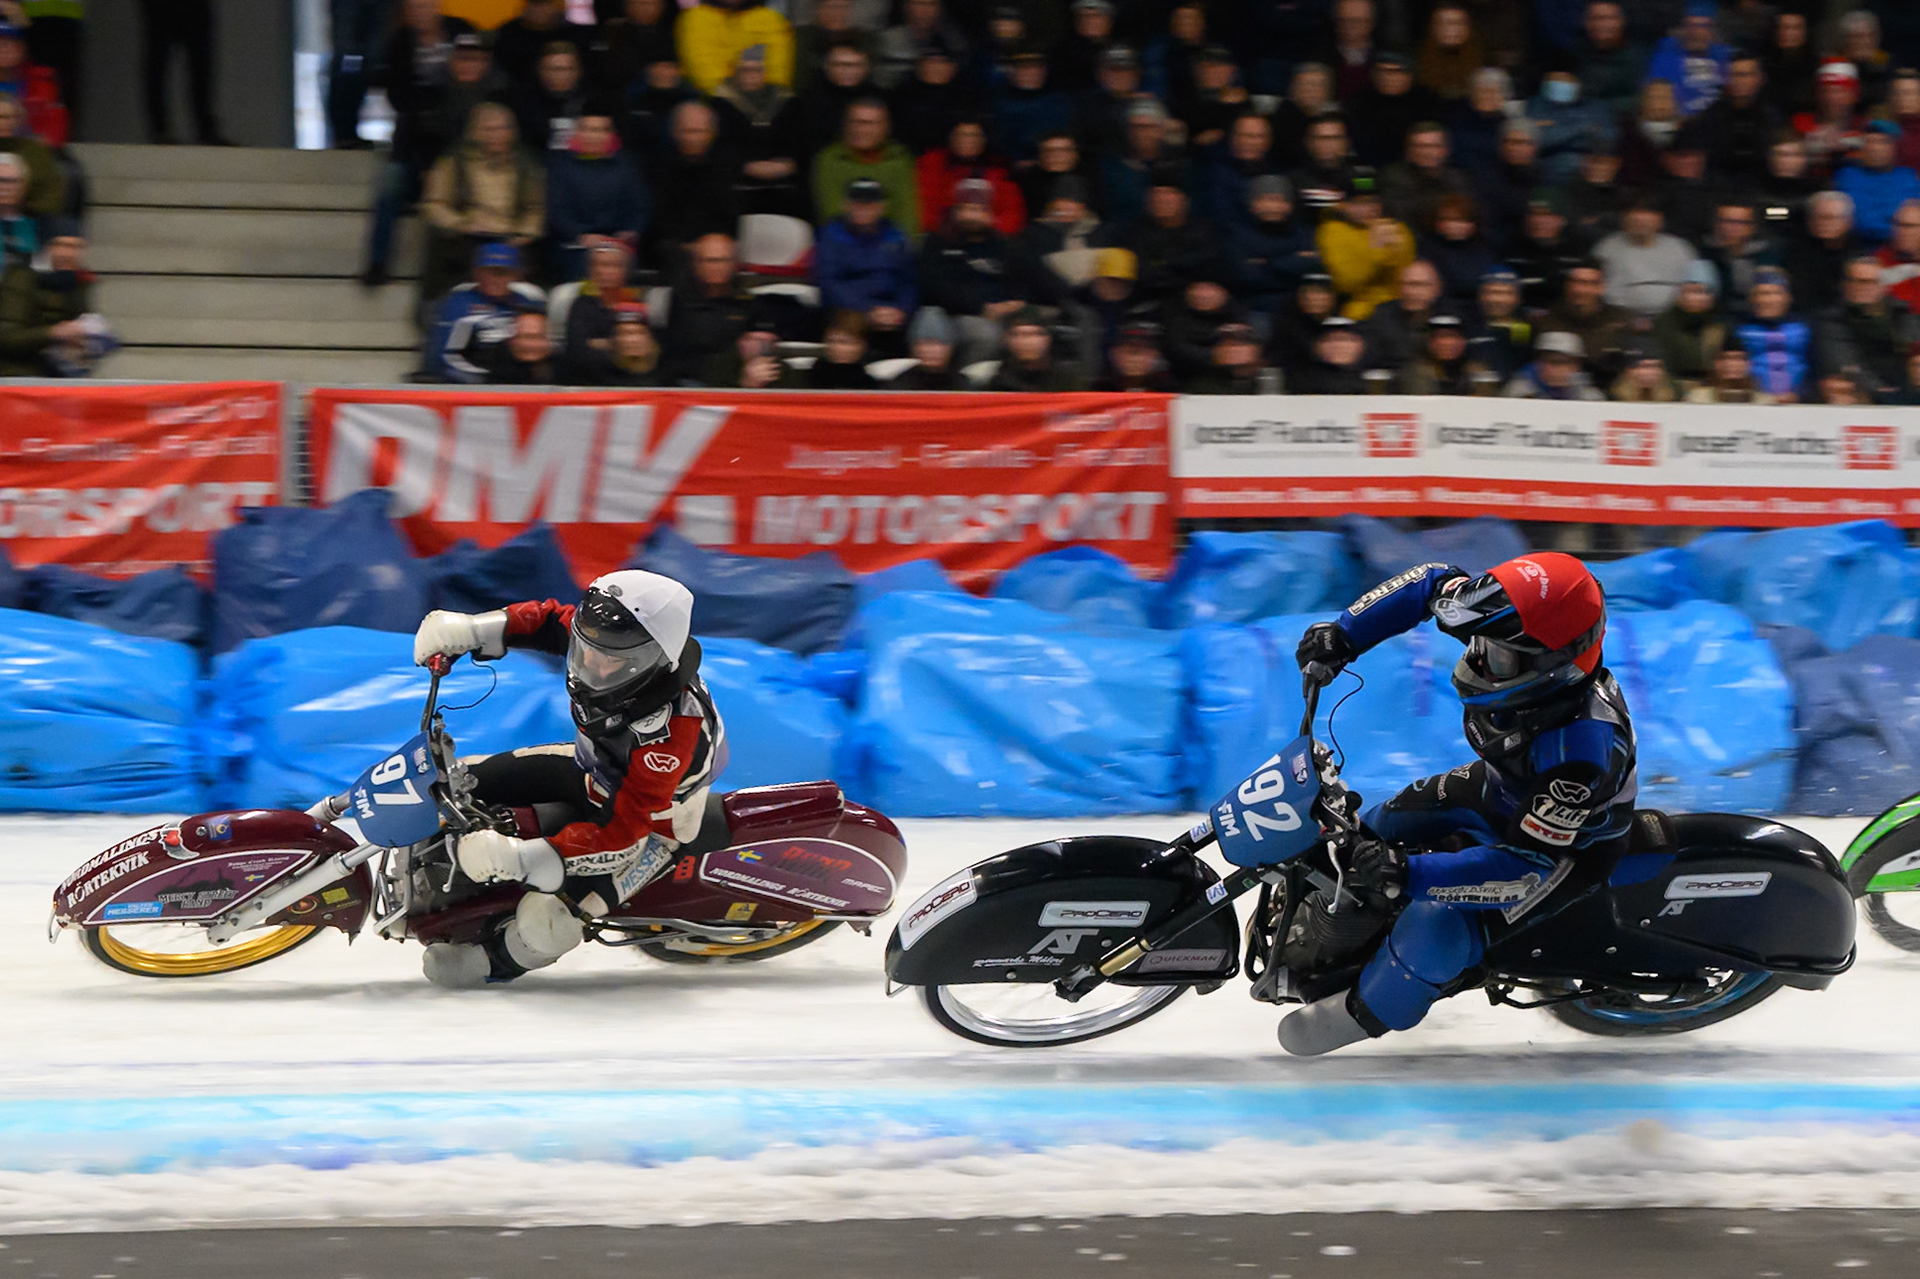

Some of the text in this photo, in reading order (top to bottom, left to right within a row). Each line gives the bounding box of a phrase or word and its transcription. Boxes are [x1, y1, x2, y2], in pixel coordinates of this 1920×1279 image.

[752, 491, 1168, 545] MOTORSPORT
[370, 753, 424, 805] 97
[354, 786, 375, 819] FIM
[1217, 800, 1240, 837] FIM
[67, 851, 150, 909] RÖRTEKNIK
[1150, 954, 1219, 965] QUICKMAN
